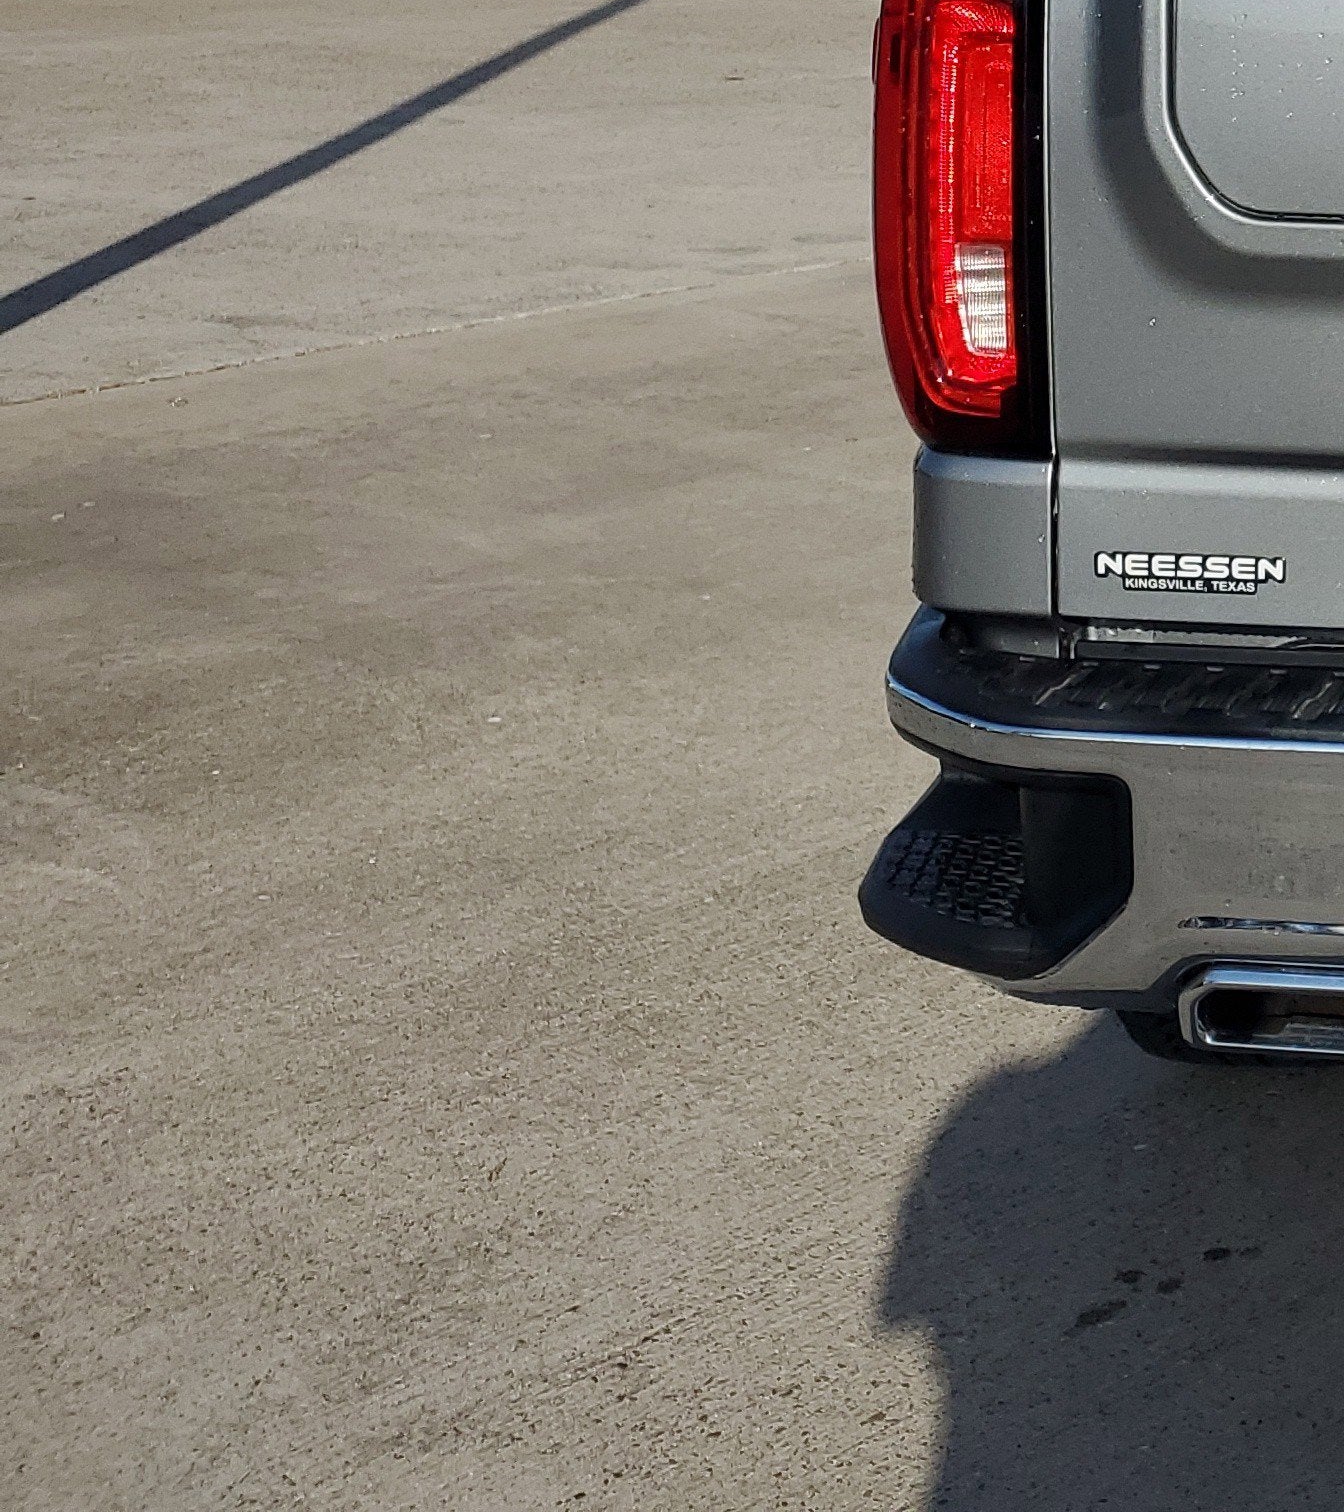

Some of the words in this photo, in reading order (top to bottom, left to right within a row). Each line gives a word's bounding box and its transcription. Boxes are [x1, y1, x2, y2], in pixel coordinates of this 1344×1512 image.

[1096, 552, 1285, 581] NEESSEN
[1125, 577, 1208, 592] KINGSVILLE,
[1211, 580, 1256, 593] TEXAS
